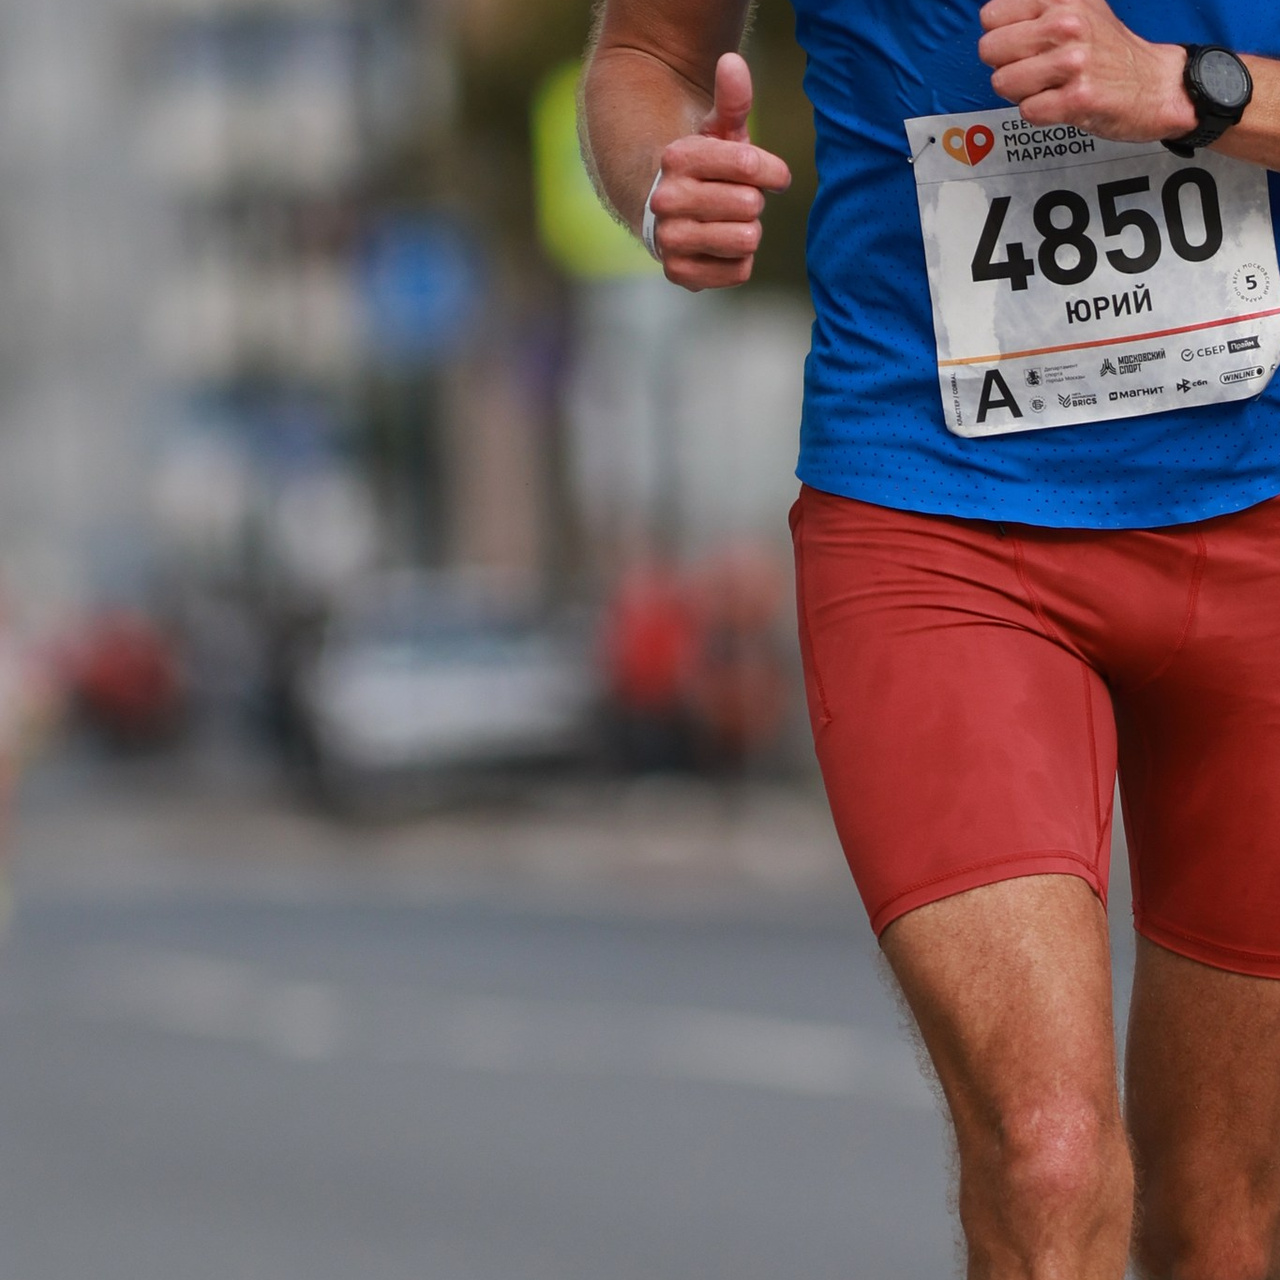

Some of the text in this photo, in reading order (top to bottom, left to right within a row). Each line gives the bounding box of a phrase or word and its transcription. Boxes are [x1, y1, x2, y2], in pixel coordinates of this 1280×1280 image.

[1001, 119, 1033, 131] СБЕ
[1006, 139, 1095, 162] МАРАФОН
[971, 167, 1223, 291] 4850
[1245, 274, 1258, 290] 5
[1065, 283, 1153, 324] ЮРИЙ
[1117, 348, 1166, 365] МОСКОВСКИЙ
[1196, 340, 1255, 357] СБЕР Прайм
[1119, 363, 1142, 375] СПОРТ
[1223, 369, 1256, 382] WINLINE
[1119, 385, 1165, 399] магнит
[1072, 397, 1098, 407] BRICS
